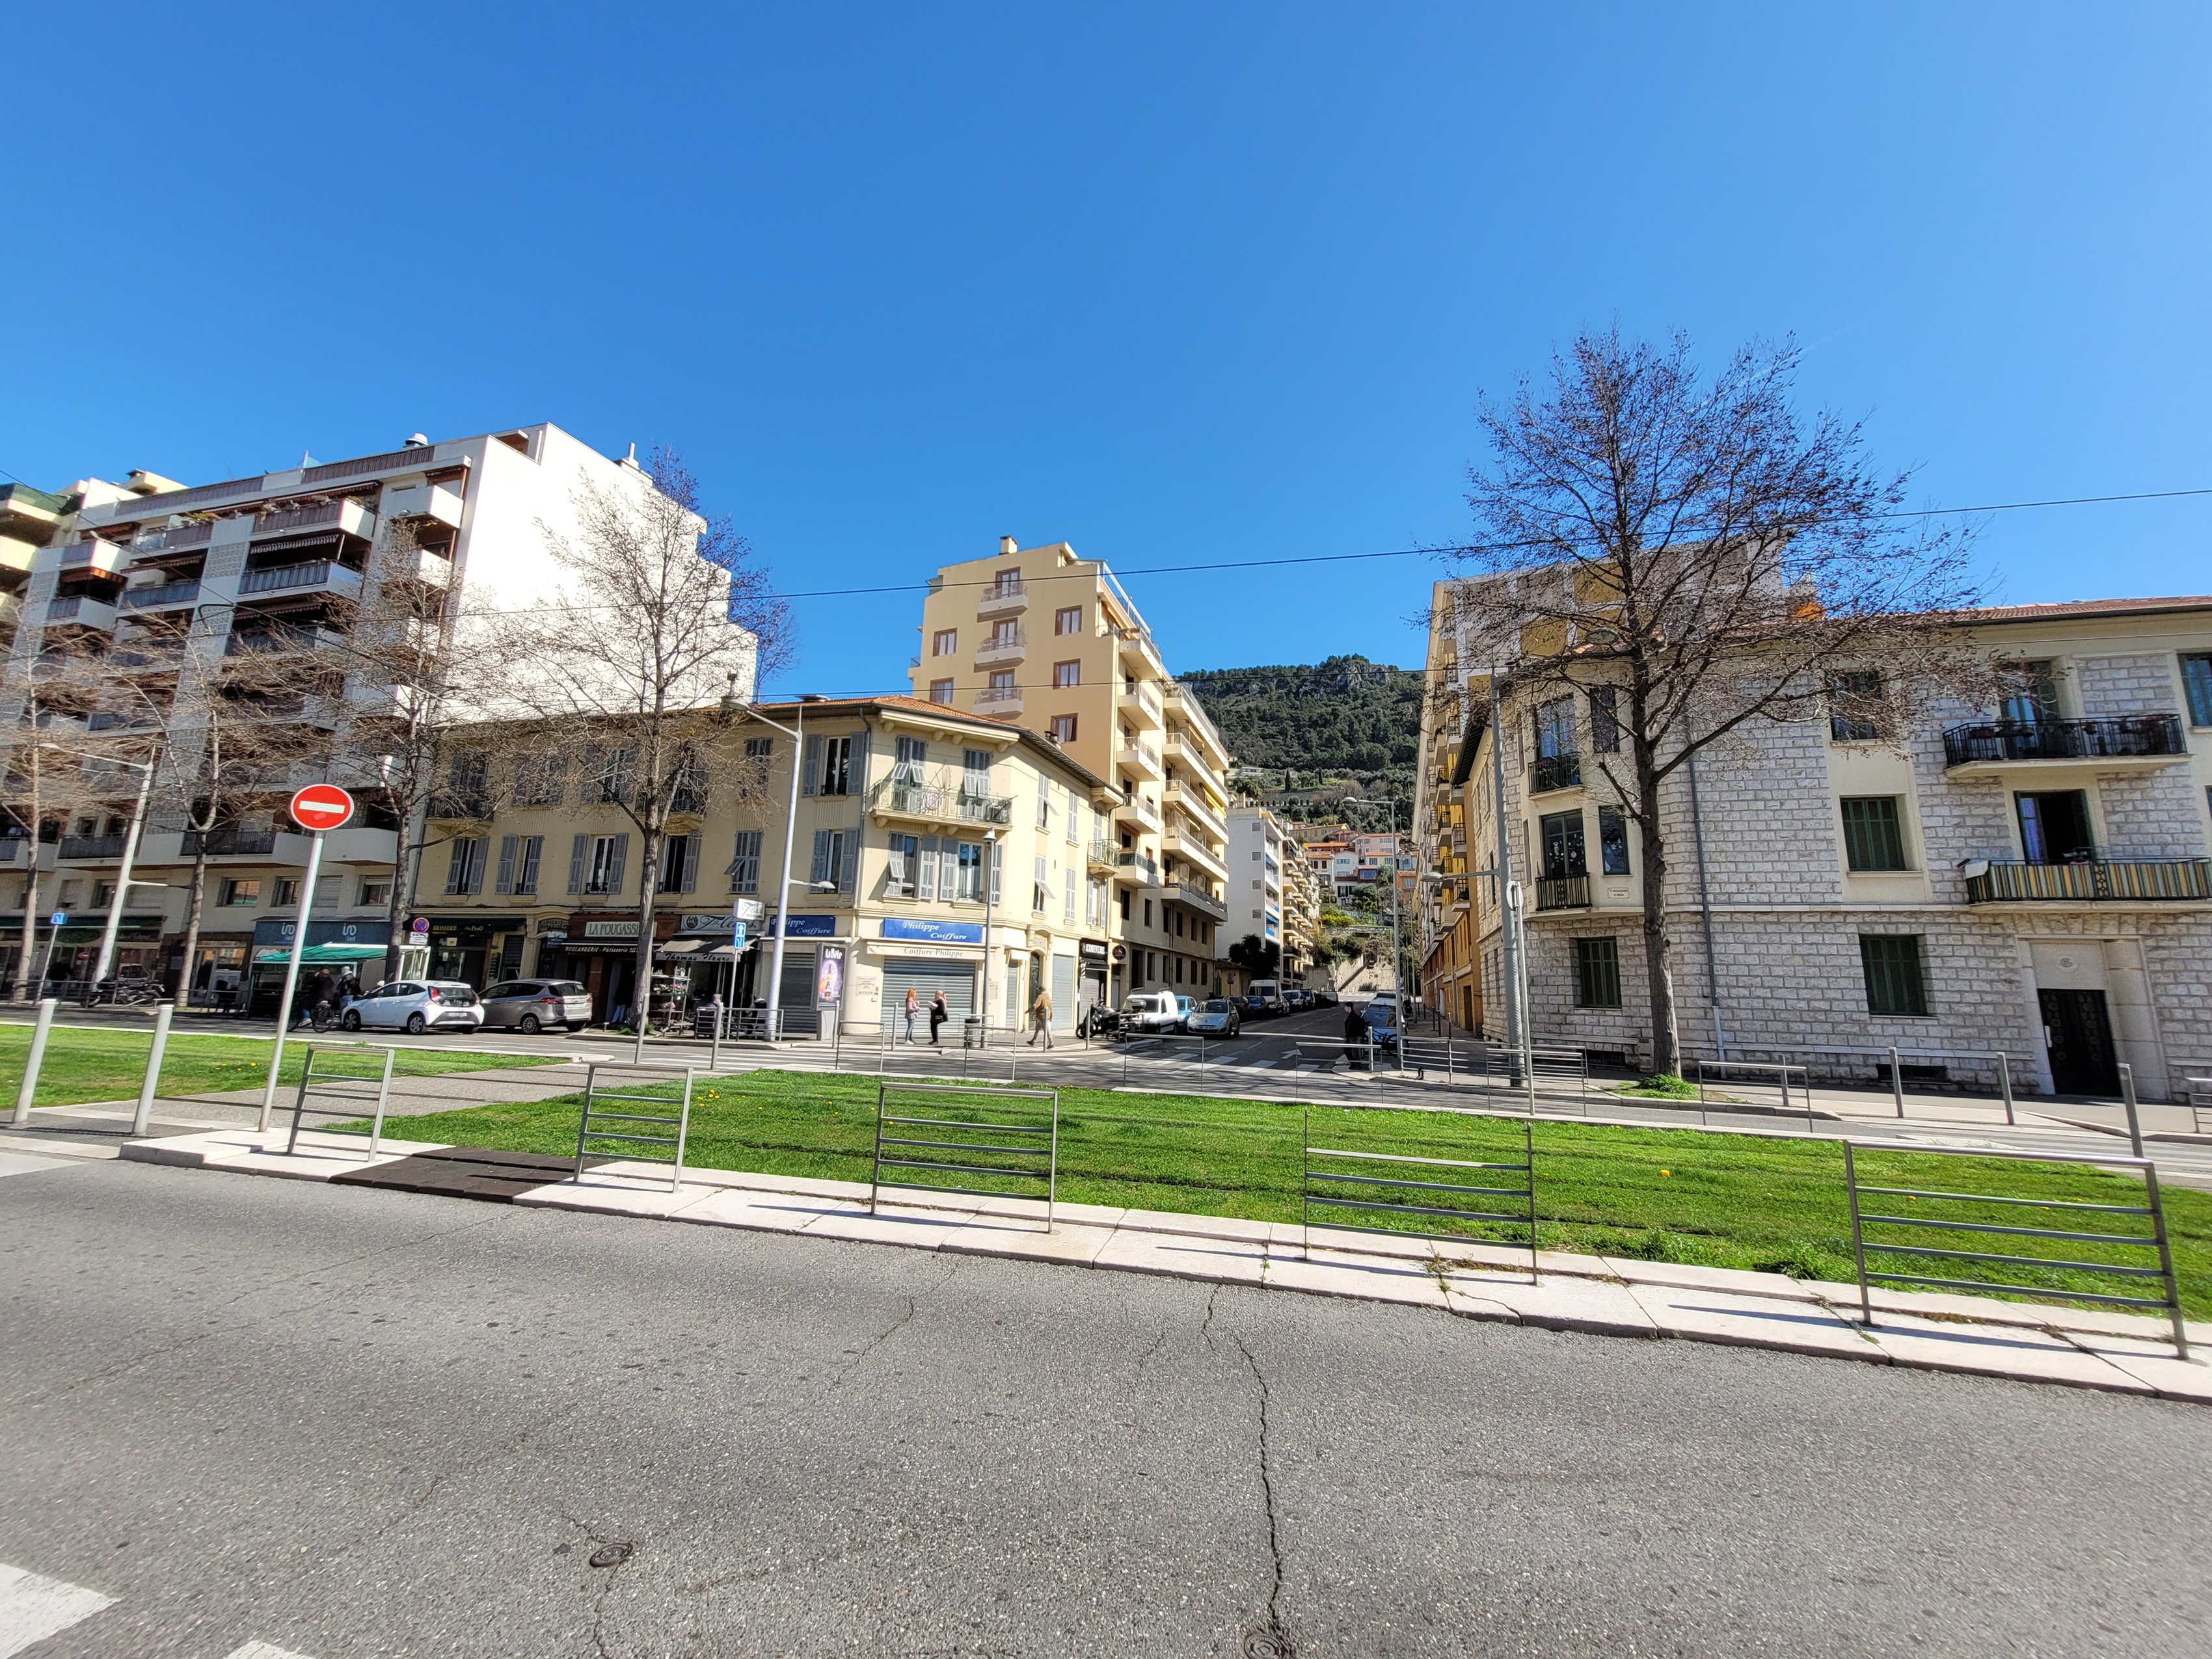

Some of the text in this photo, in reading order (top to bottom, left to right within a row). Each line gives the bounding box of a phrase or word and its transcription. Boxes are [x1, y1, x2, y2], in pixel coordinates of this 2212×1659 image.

[771, 918, 805, 928] Plippe
[902, 921, 939, 932] Philippe
[589, 923, 599, 935] LA
[702, 953, 730, 962] Fleurs
[904, 947, 964, 958] Coiffure Philippe
